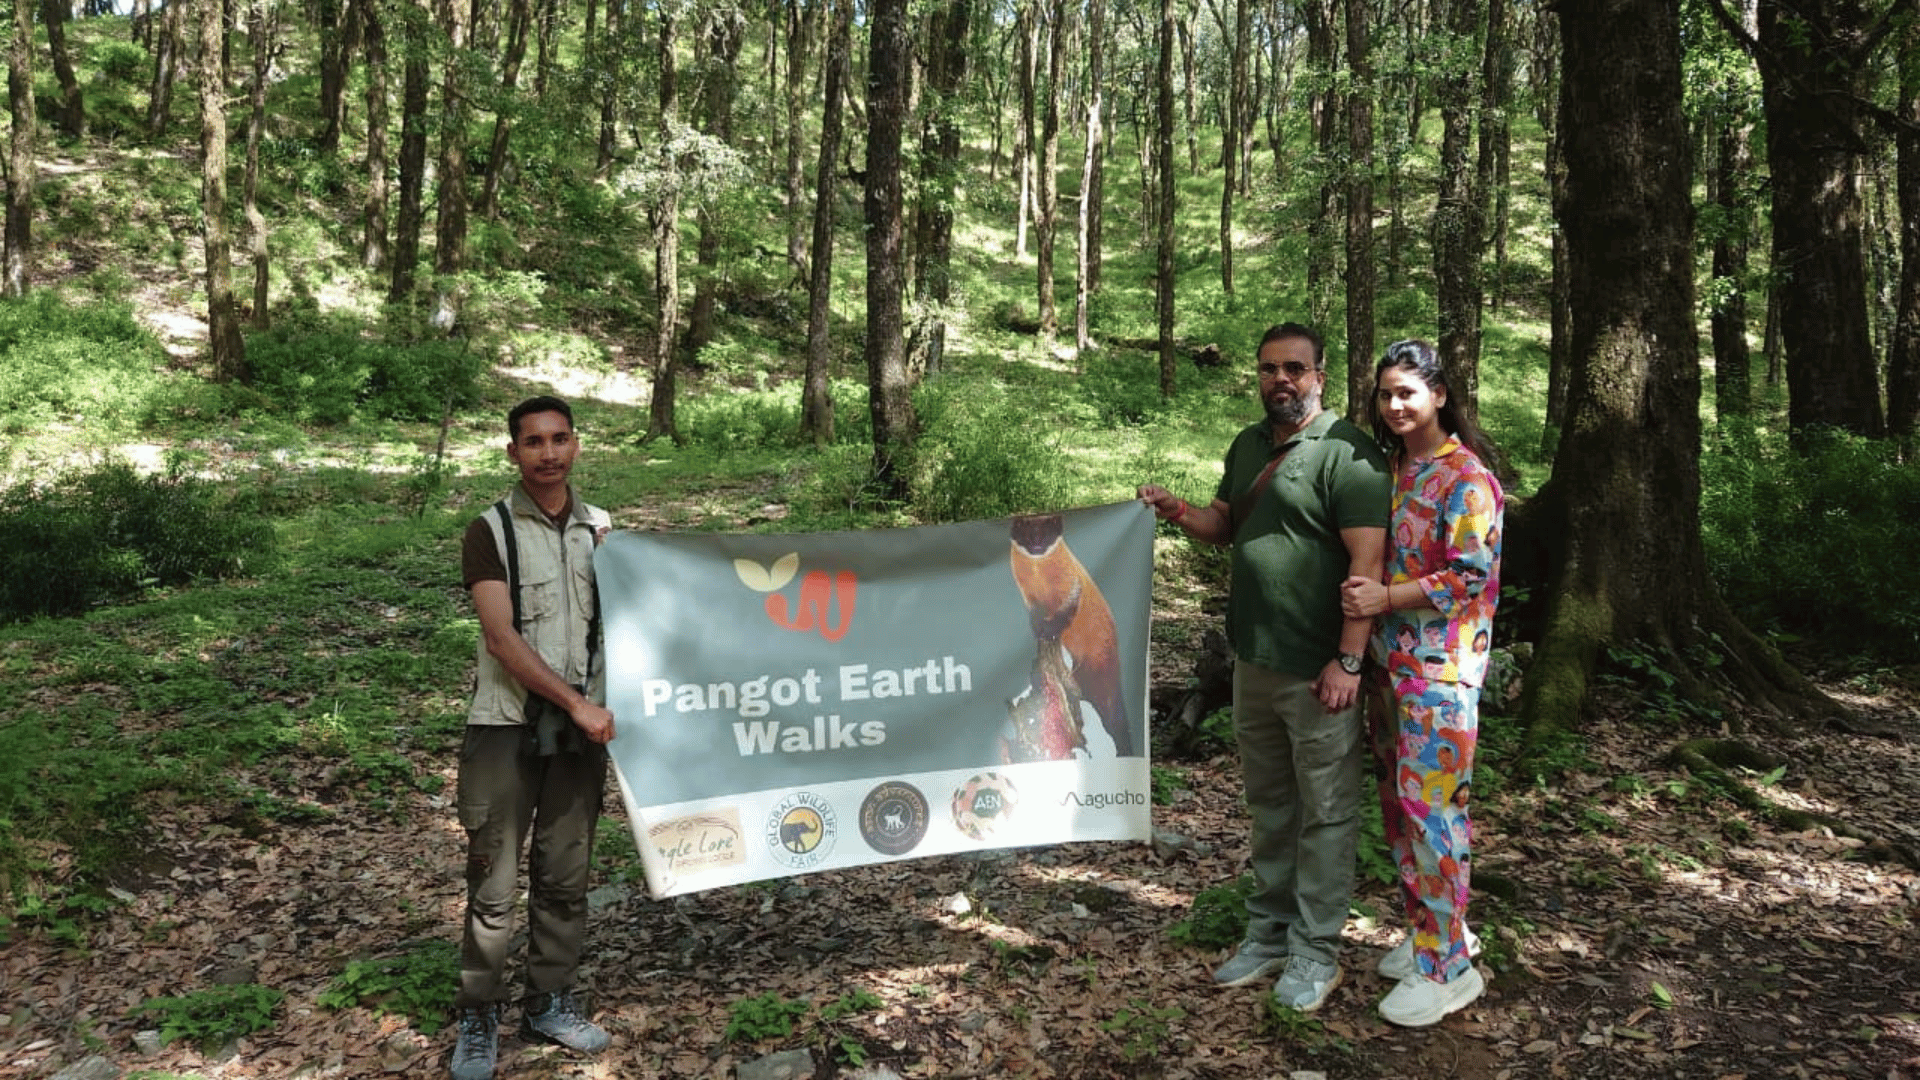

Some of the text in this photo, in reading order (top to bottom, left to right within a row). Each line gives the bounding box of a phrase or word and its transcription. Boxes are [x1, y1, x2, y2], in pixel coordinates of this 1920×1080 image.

[642, 656, 972, 717] Pangot Earth
[732, 715, 887, 756] Walks
[768, 798, 794, 846] GLOBAL
[798, 792, 835, 838] WILDLIFE
[791, 853, 819, 869] FAIR
